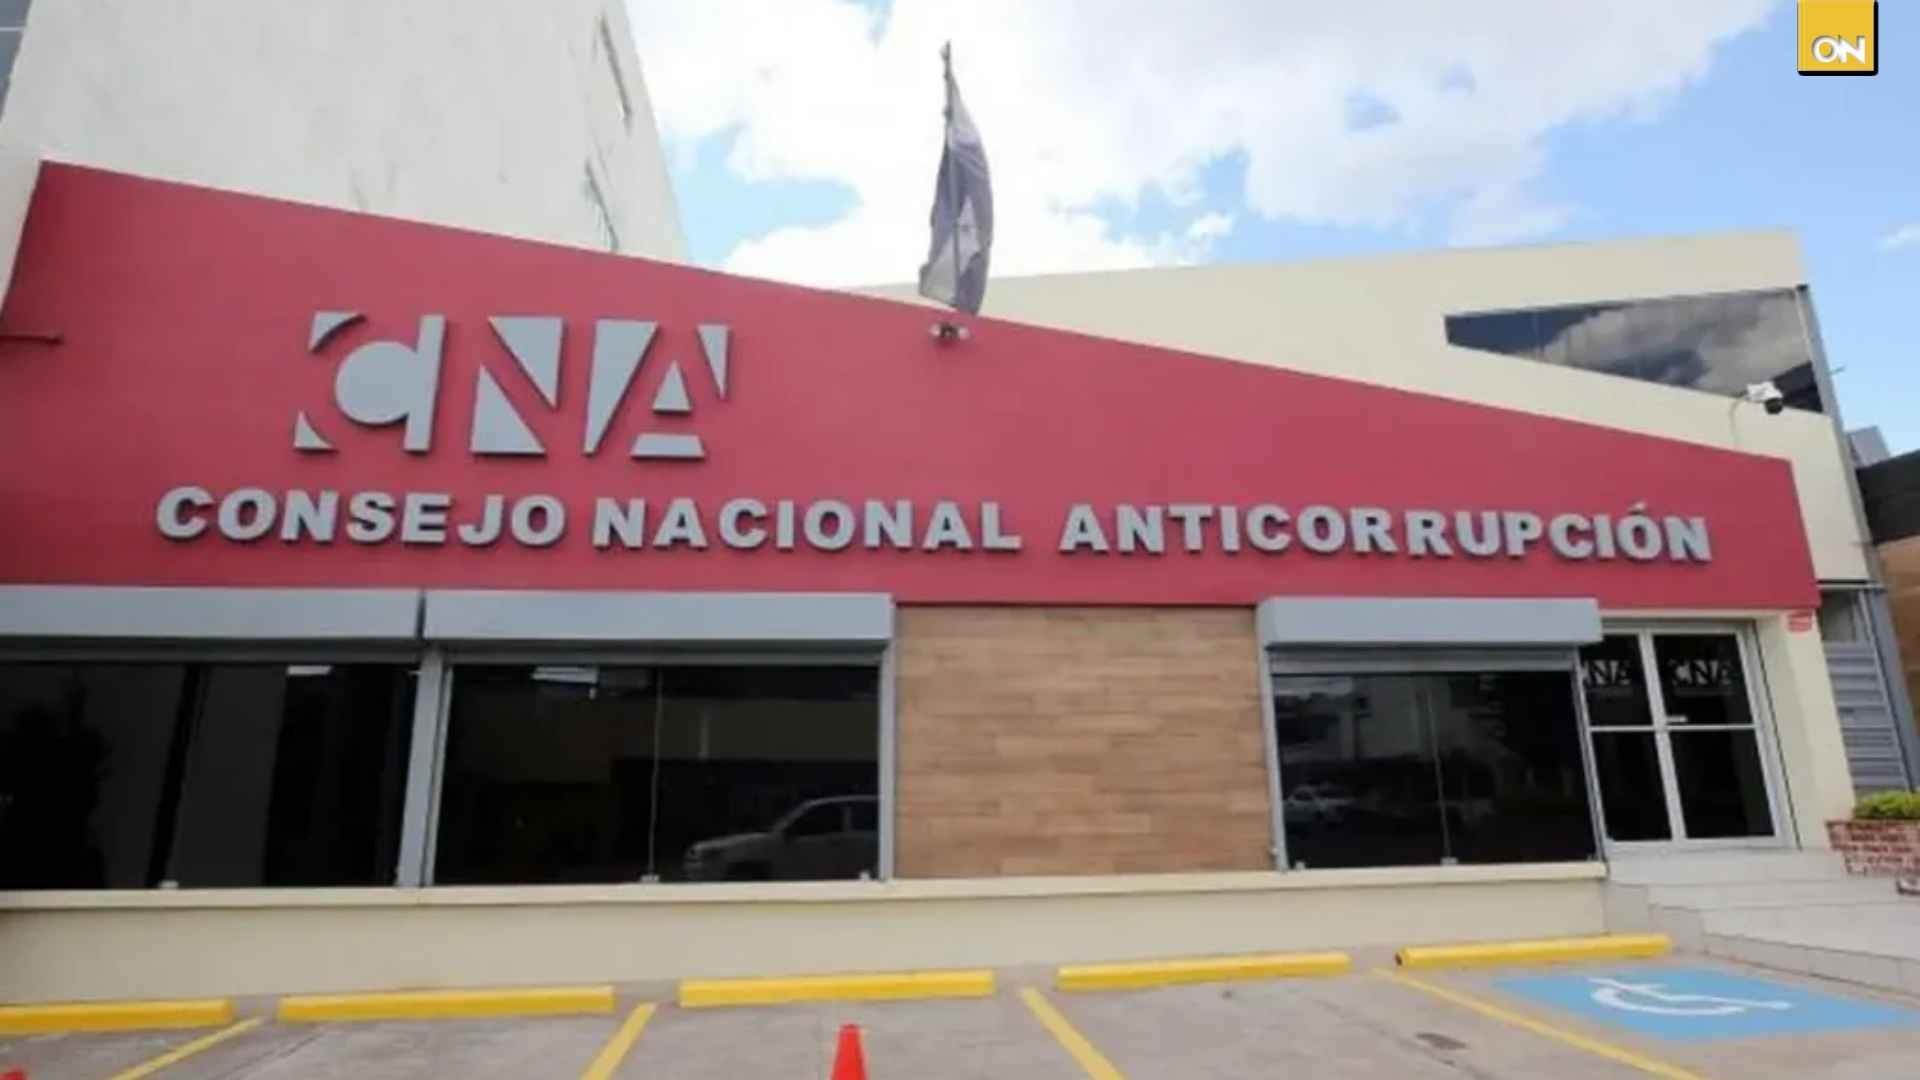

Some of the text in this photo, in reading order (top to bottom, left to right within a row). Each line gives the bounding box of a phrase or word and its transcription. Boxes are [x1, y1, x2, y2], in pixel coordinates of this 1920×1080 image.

[293, 311, 729, 459] CNA
[156, 486, 1711, 562] CONSEJO NACIONAL ANTICORRUPCIÓN
